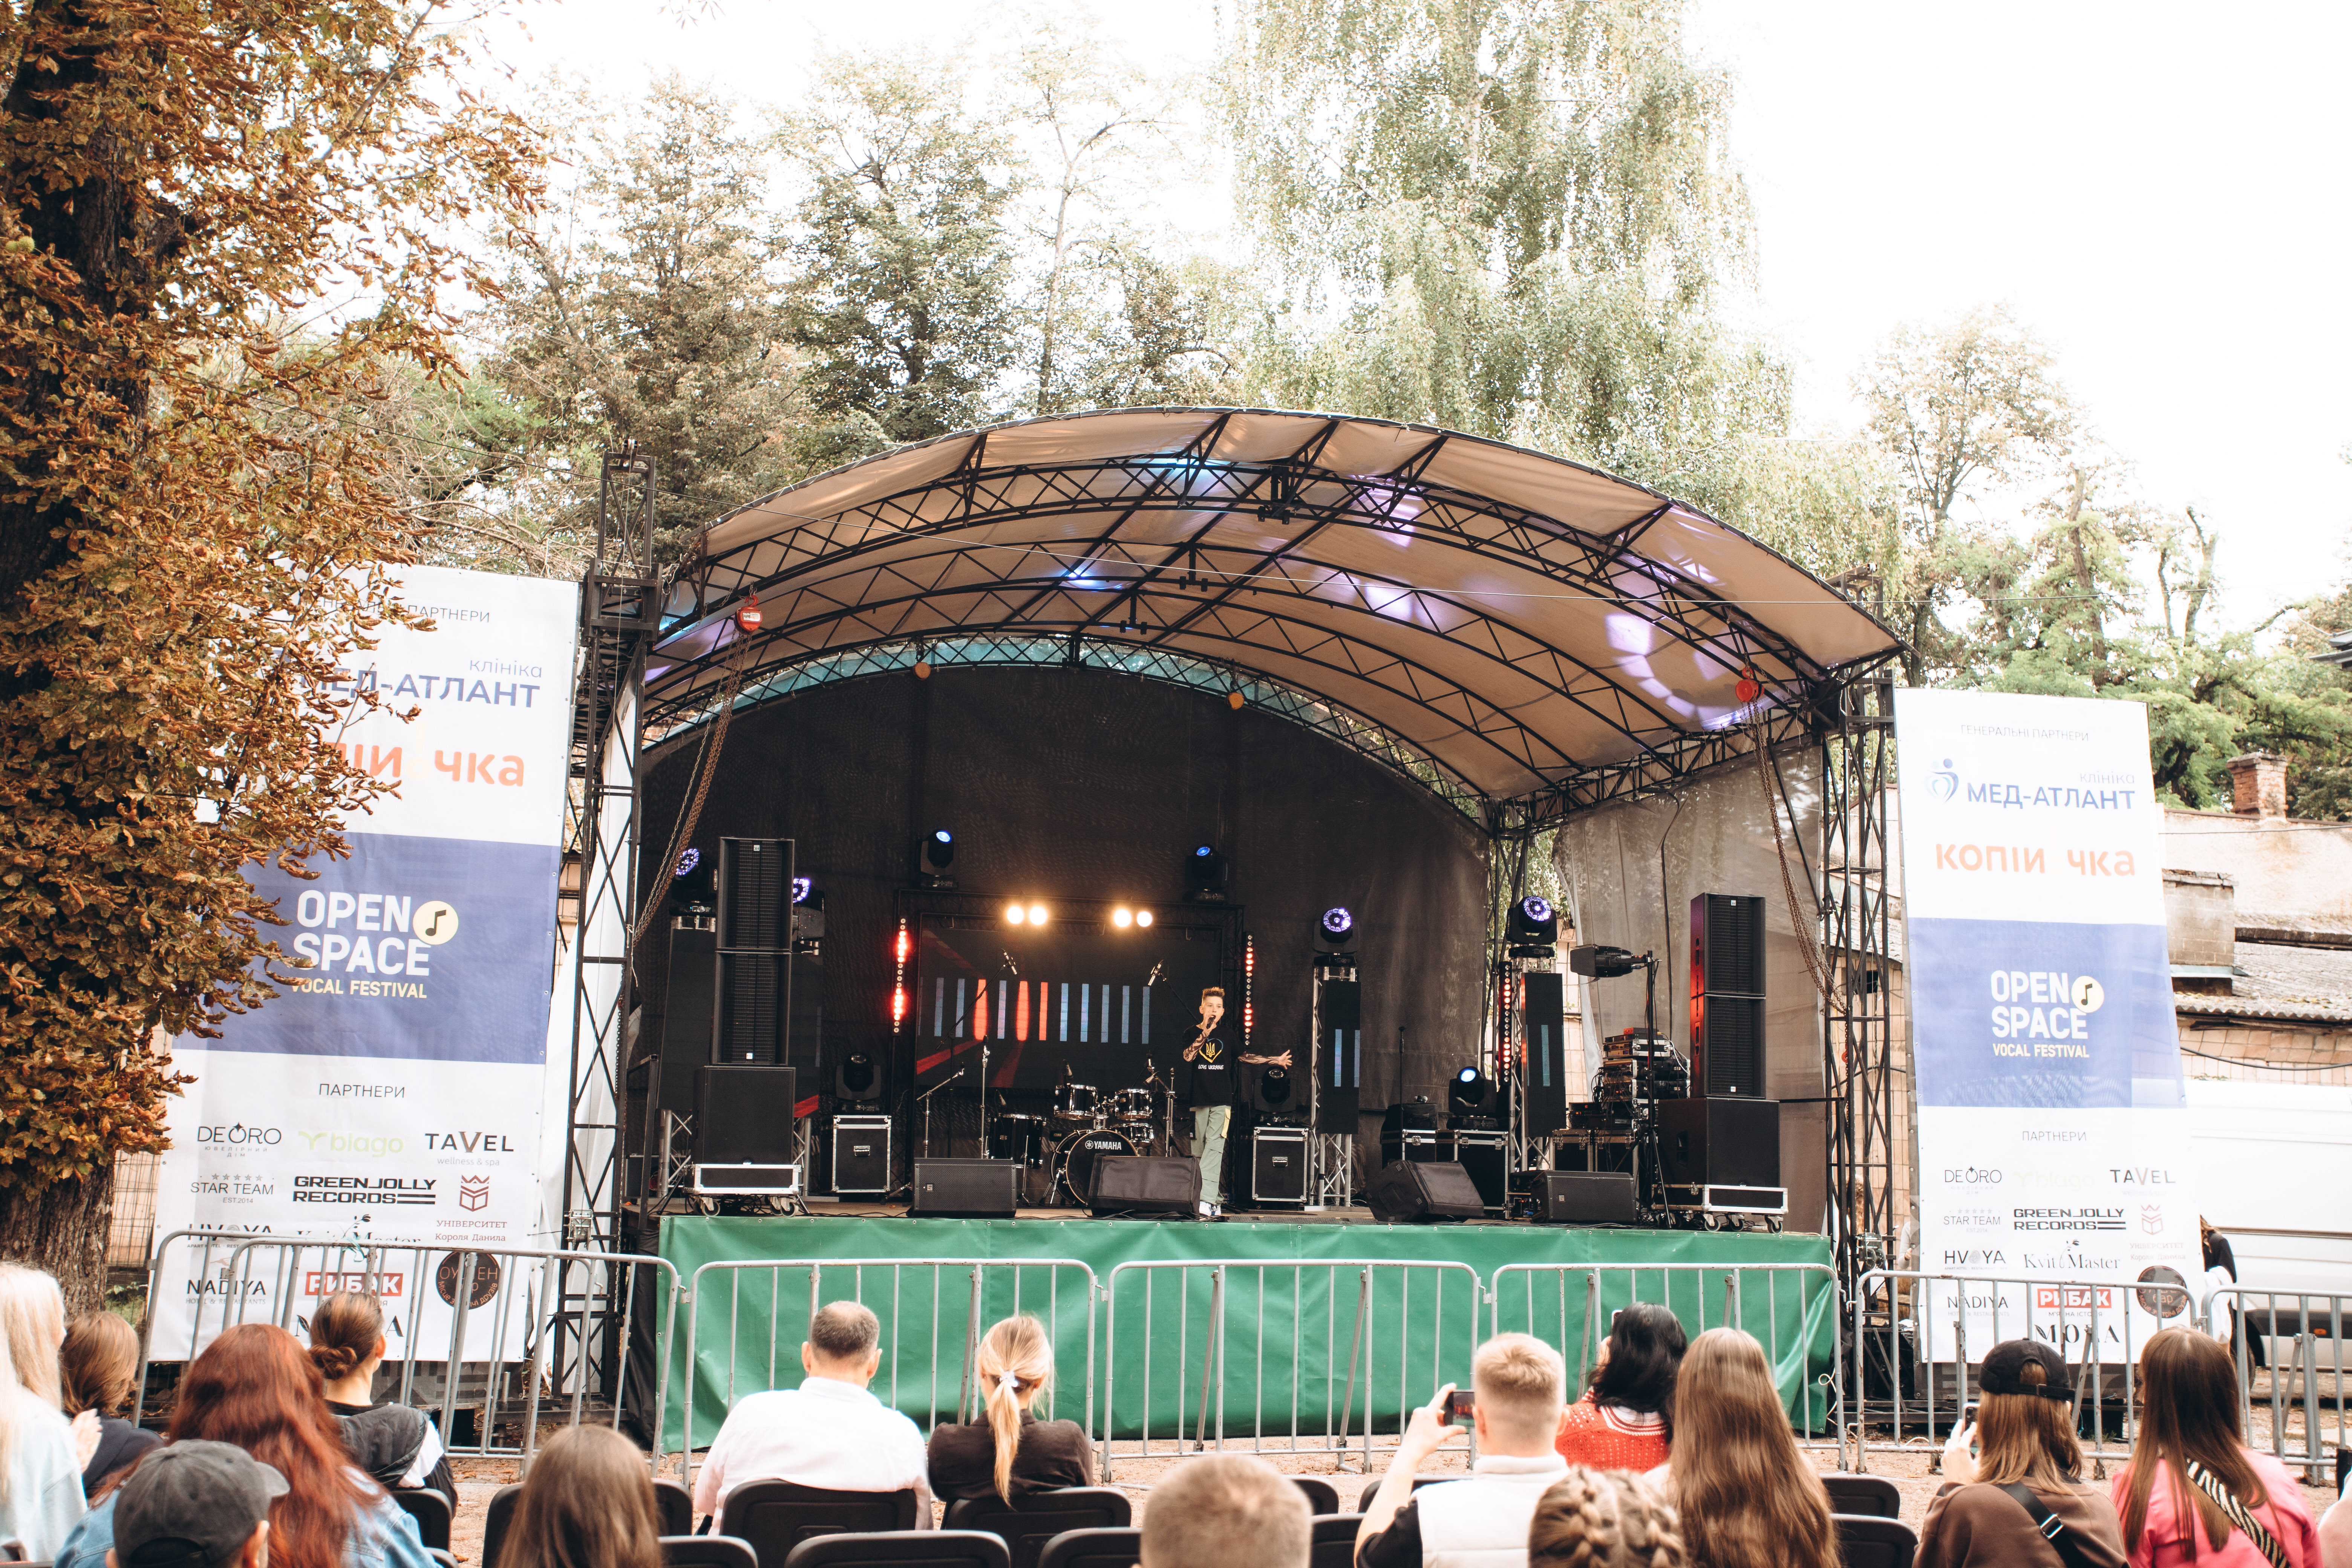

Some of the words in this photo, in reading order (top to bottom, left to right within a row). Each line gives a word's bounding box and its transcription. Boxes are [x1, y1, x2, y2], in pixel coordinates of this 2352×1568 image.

[408, 605, 490, 623] ПАРТНЕРИ
[470, 658, 542, 678] клініка
[300, 666, 540, 708] ЕД-АТЛАНТ
[1961, 725, 2029, 738] ГЕНЕРАЛЬНІ
[2033, 729, 2089, 741] ПАРТНЕРИ
[2080, 771, 2135, 784] клініка
[1967, 782, 2135, 809] МЕД-АТЛАНТ
[297, 890, 411, 932] OPEN
[294, 933, 431, 976] SPACE
[292, 978, 344, 994] VOCAL
[350, 980, 427, 998] FESTIVAL
[1991, 970, 2069, 1003] OPEN
[1992, 1006, 2088, 1039] SPACE
[1992, 1043, 2030, 1057] VOCAL
[2034, 1044, 2090, 1058] FESTIVAL
[319, 1083, 405, 1098] ПАРТНЕРИ
[197, 1126, 282, 1144] DEORO
[425, 1131, 514, 1153] TAVEL
[2023, 1131, 2086, 1141] ПАРТНЕРИ
[330, 1132, 404, 1158] blago
[1094, 1141, 1122, 1150] YAMAHA
[1945, 1170, 2002, 1183] DEORO
[2110, 1167, 2176, 1185] TAVEL
[191, 1182, 228, 1194] STAR
[233, 1183, 274, 1194] TEAM
[292, 1191, 396, 1204] RECORDS
[1943, 1216, 1969, 1225] STAR
[1972, 1216, 2000, 1225] TEAM
[2014, 1221, 2096, 1230] RECORDS
[435, 1233, 468, 1242] Короля
[2024, 1254, 2057, 1268] Kvit
[2067, 1254, 2120, 1268] Master
[440, 1266, 498, 1280] ОУЕН
[2040, 1291, 2109, 1306] РИБАК
